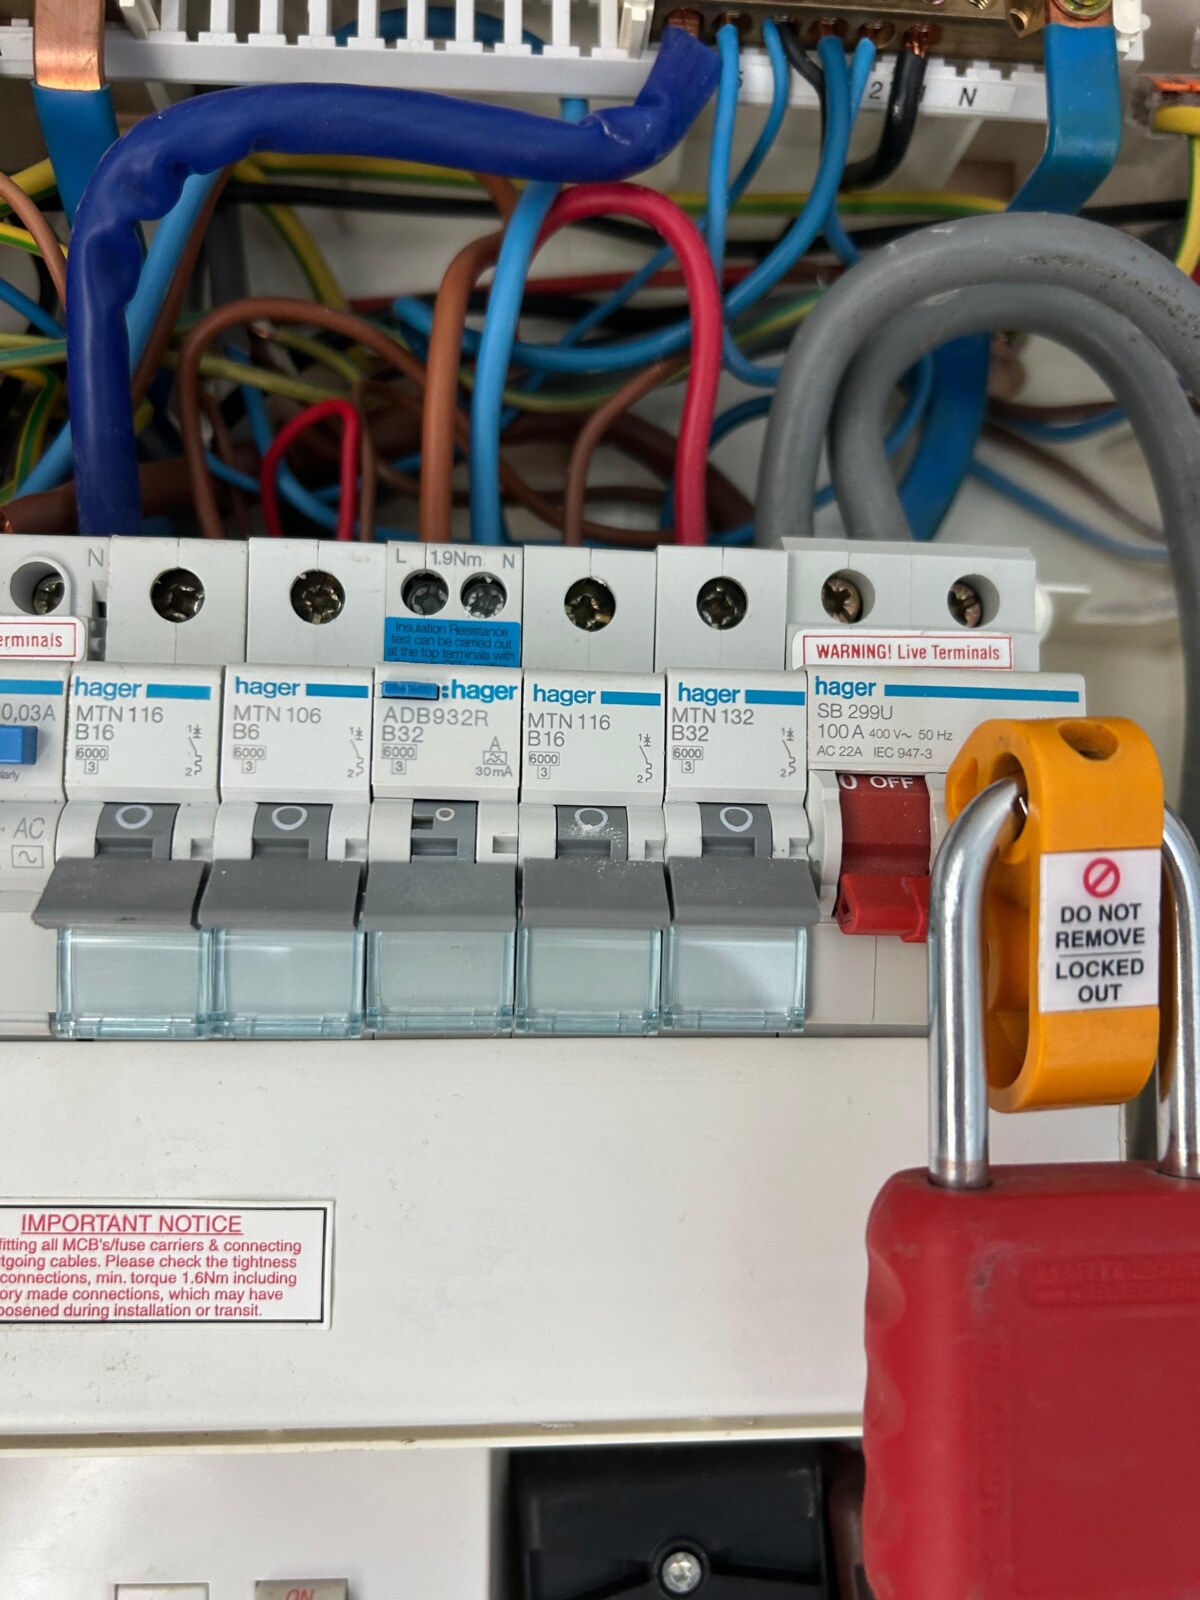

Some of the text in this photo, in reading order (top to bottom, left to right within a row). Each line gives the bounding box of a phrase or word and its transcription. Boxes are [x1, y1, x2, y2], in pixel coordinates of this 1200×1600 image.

[868, 81, 883, 99] 2
[958, 87, 978, 107] N
[87, 549, 104, 567] N
[396, 548, 407, 564] L
[430, 550, 482, 567] 1.9Nm
[502, 554, 515, 569] N
[395, 622, 509, 637] Insulation Resistance
[391, 634, 412, 642] test
[414, 636, 435, 645] can
[439, 637, 452, 647] be
[494, 640, 512, 650] out
[387, 646, 515, 662] at the top terminals with
[816, 644, 1000, 660] WARNING! Live Terminals
[74, 676, 142, 701] hager
[234, 676, 301, 699] hager
[533, 683, 596, 706] hager
[678, 682, 741, 706] hager
[815, 676, 876, 699] hager
[76, 705, 164, 723] MTN 116
[233, 705, 322, 724] MTN 106
[383, 706, 489, 726] ADB932R
[672, 707, 755, 725] MTN 132
[817, 703, 894, 720] SB 299U
[528, 712, 611, 730] MTN 116
[75, 723, 115, 741] B16
[232, 723, 260, 740] B6
[382, 725, 424, 743] B32
[527, 730, 565, 747] B16
[671, 725, 709, 742] B32
[818, 724, 849, 739] 100
[851, 725, 865, 739] A
[869, 728, 891, 739] 400
[918, 730, 934, 740] 50
[937, 730, 953, 741] Hz
[382, 745, 416, 758] 6000
[489, 736, 501, 751] A
[816, 745, 933, 759] AC 22A IEC 947-3
[76, 747, 107, 759] 6000
[233, 747, 265, 759] 6000
[529, 754, 558, 765] 6000
[673, 748, 702, 759] 6000
[87, 762, 96, 772] 3
[245, 761, 253, 772] 3
[395, 761, 404, 772] 3
[540, 767, 548, 777] 3
[684, 761, 692, 771] 3
[869, 775, 914, 789] OFF
[12, 817, 46, 840] AC
[1060, 902, 1142, 924] DO NOT
[1055, 927, 1146, 949] REMOVE
[1055, 957, 1145, 980] LOCKED
[1078, 983, 1122, 1003] OUT
[21, 1213, 242, 1233] IMPORTANT NOTICE
[41, 1238, 58, 1251] all
[62, 1238, 146, 1251] MCB's/fuse
[150, 1238, 204, 1252] carriers
[208, 1239, 220, 1252] &
[223, 1239, 302, 1255] connecting
[50, 1254, 101, 1268] cables.
[105, 1254, 155, 1268] Please
[159, 1255, 202, 1268] check
[205, 1255, 229, 1268] the
[233, 1255, 297, 1271] tightness
[0, 1271, 297, 1287] connections, min. torque 1.6Nm including
[0, 1287, 284, 1304] ory made connections, which may have
[63, 1303, 110, 1320] during
[114, 1303, 191, 1317] installation
[195, 1305, 211, 1317] or
[214, 1303, 263, 1317] transit.
